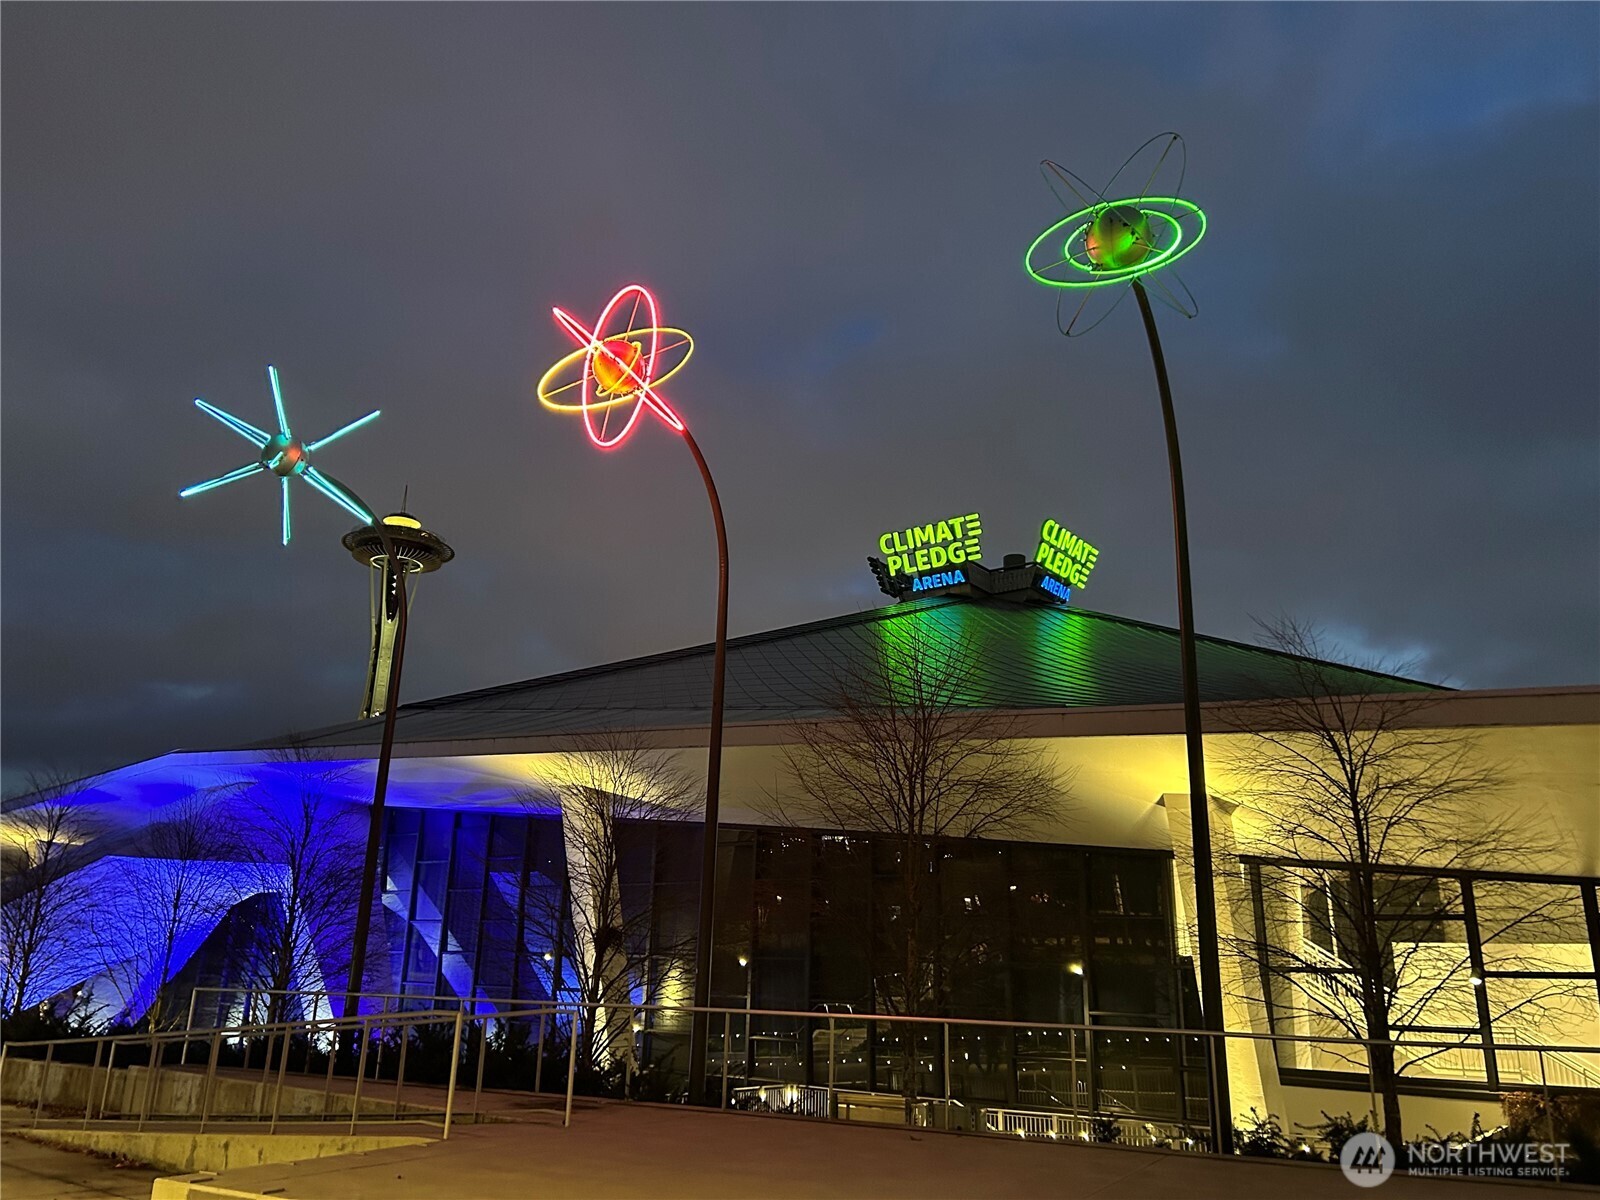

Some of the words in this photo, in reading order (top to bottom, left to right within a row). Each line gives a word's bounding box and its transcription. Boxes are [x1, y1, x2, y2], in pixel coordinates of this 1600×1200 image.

[879, 513, 982, 555] CLIMATE
[1041, 518, 1099, 569] CLIMATE
[887, 538, 982, 577] PLEDGE
[1035, 542, 1090, 590] PLEDGE
[912, 569, 966, 592] ARENA
[1040, 575, 1071, 602] ARENA
